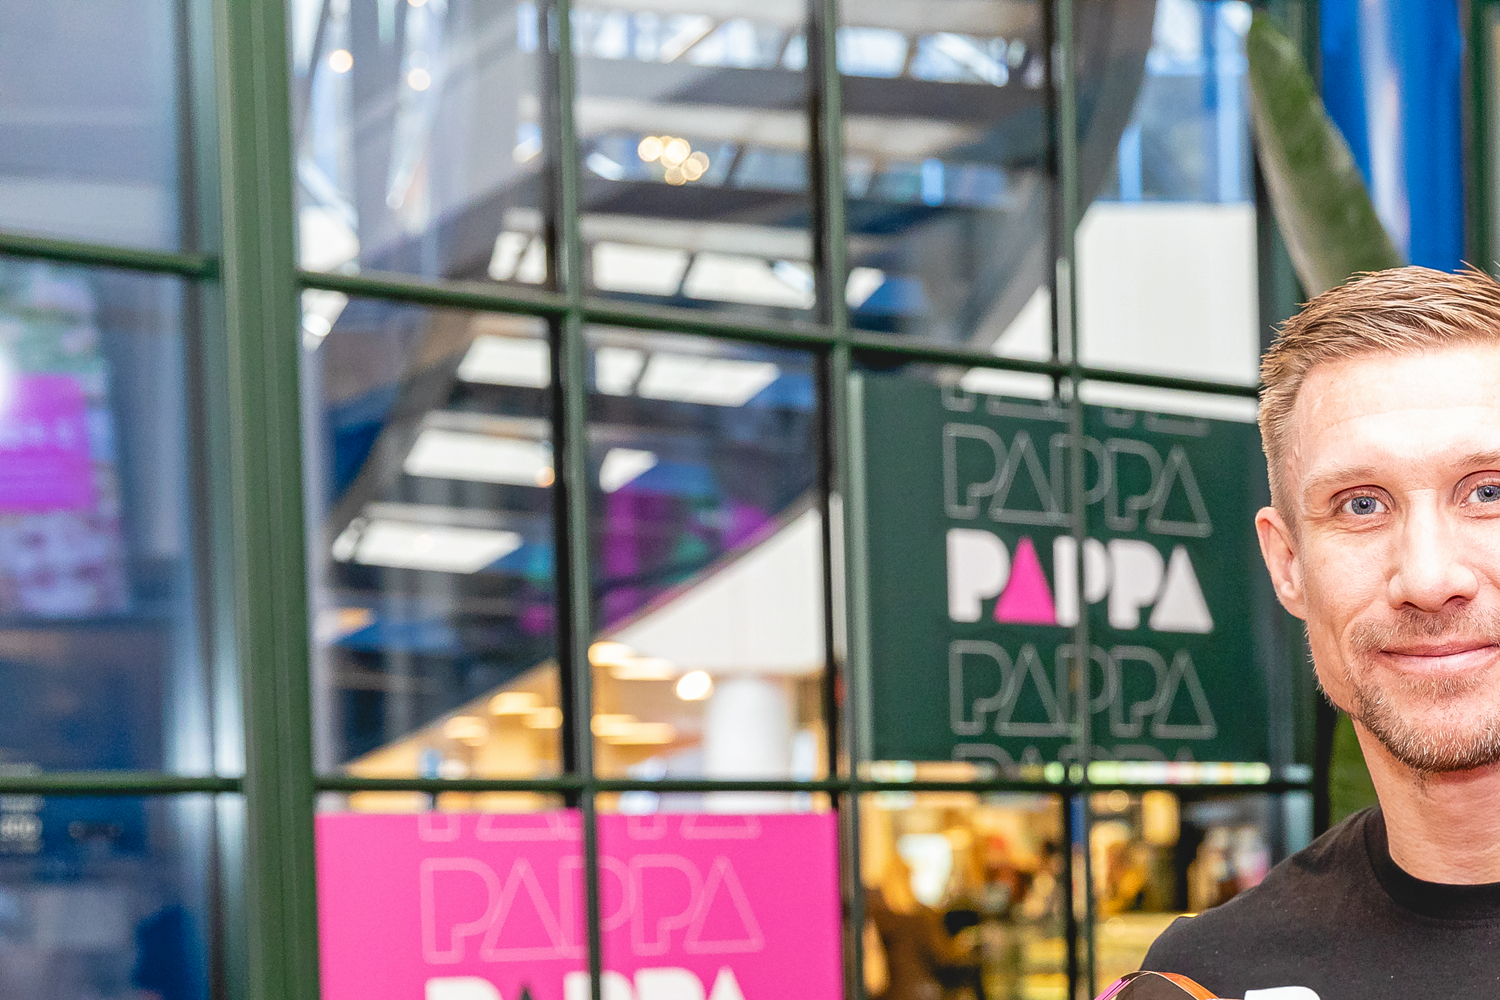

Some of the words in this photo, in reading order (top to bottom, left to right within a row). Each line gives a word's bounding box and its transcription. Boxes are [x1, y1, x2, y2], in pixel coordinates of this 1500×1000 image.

[942, 422, 1213, 538] PAPPA
[945, 527, 1215, 633] PAPPA
[948, 640, 1218, 740] PAPPA
[419, 854, 766, 964] PAPPA
